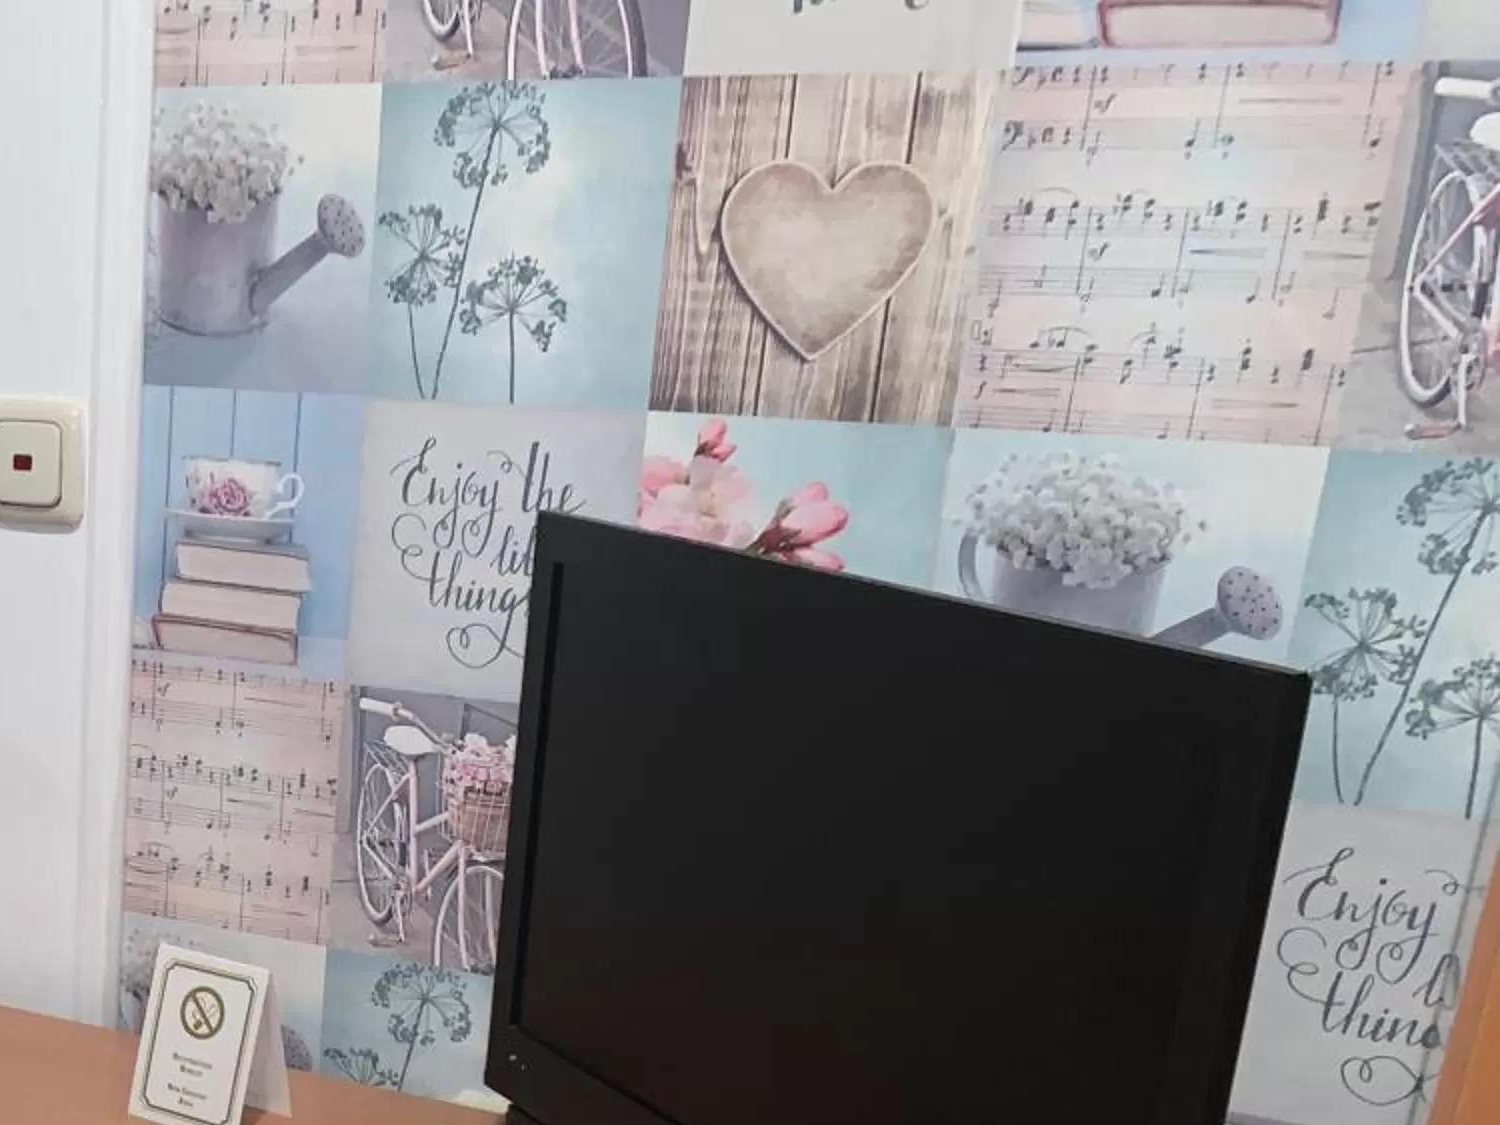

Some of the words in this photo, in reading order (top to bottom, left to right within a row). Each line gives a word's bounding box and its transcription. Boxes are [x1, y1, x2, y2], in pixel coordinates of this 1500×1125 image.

[389, 437, 501, 558] Enjoy
[488, 442, 586, 513] the
[490, 525, 536, 577] lit
[1283, 848, 1439, 984] Enjoy
